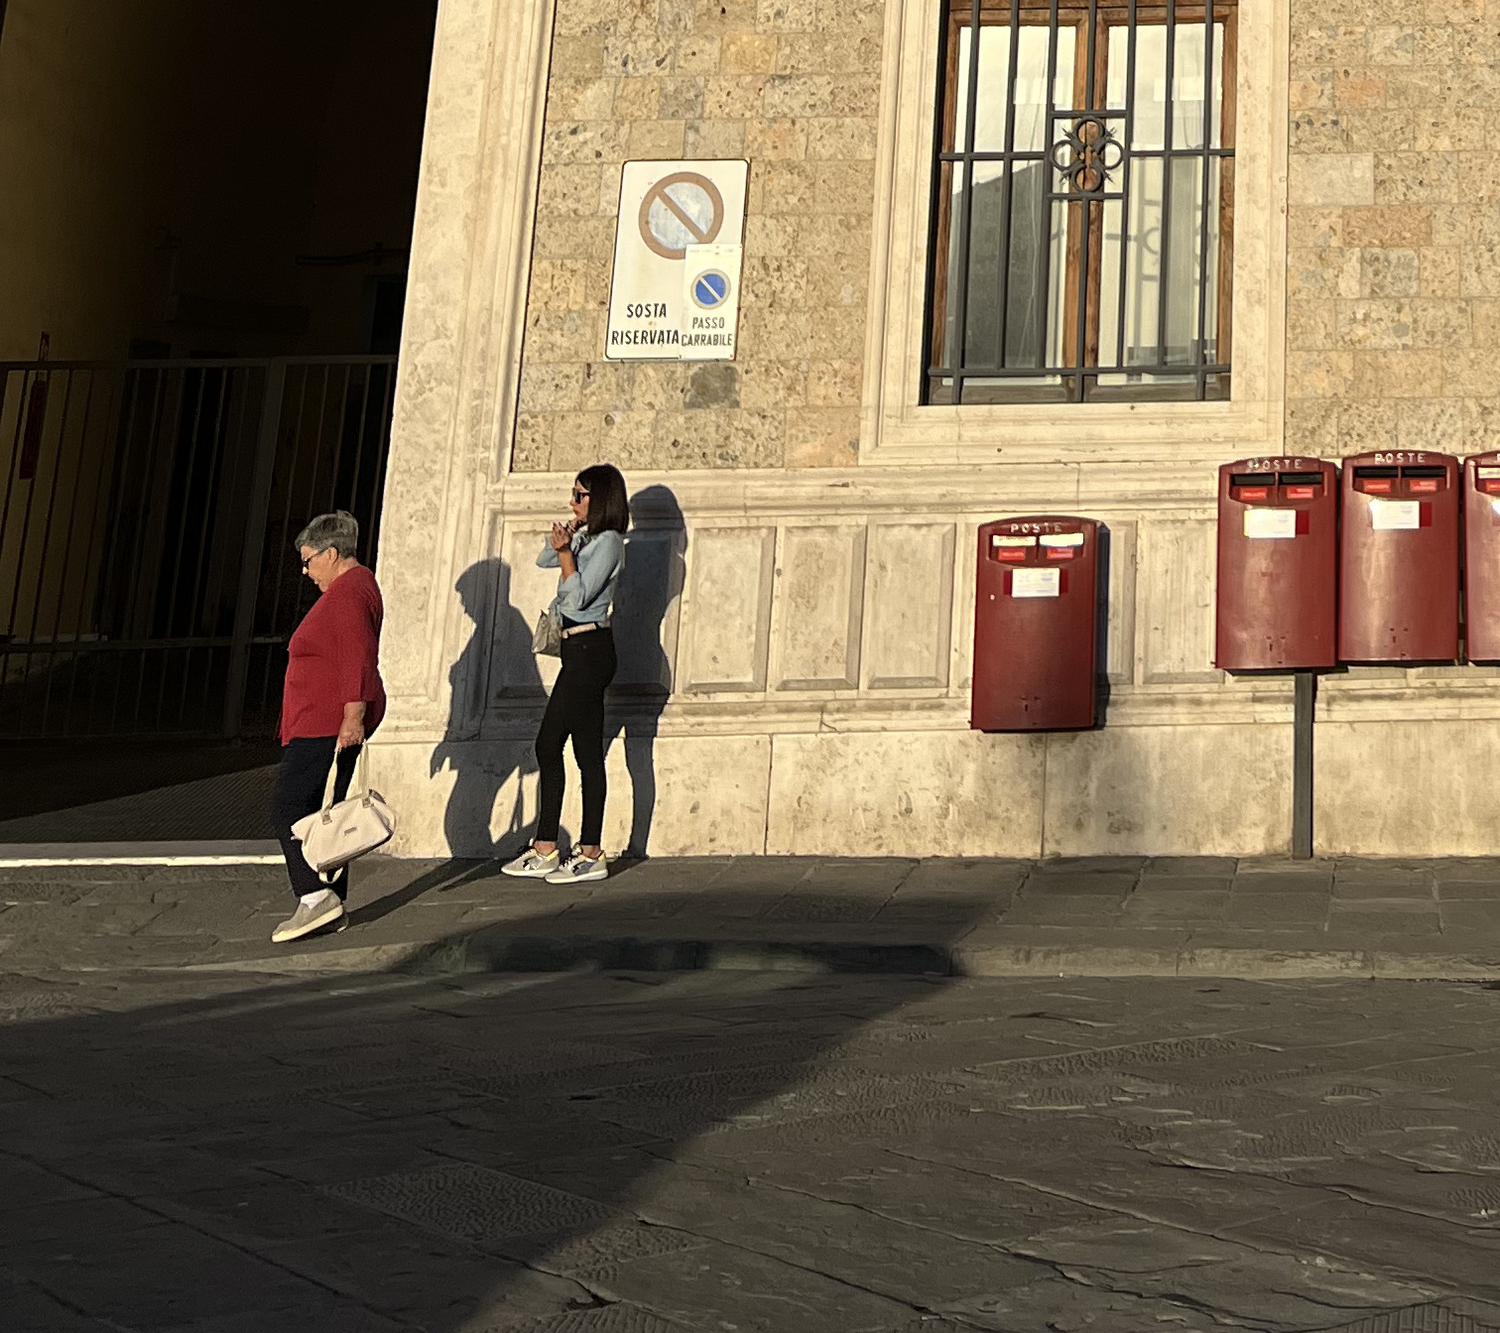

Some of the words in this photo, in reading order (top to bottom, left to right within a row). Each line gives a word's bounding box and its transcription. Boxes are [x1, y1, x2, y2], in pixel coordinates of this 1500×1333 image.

[626, 302, 668, 319] SOSTA
[691, 316, 726, 329] PASSO
[610, 328, 680, 346] RISERVATA
[681, 333, 734, 347] CARRABILE
[1374, 452, 1426, 464] POSTE
[1010, 522, 1063, 533] POSTE
